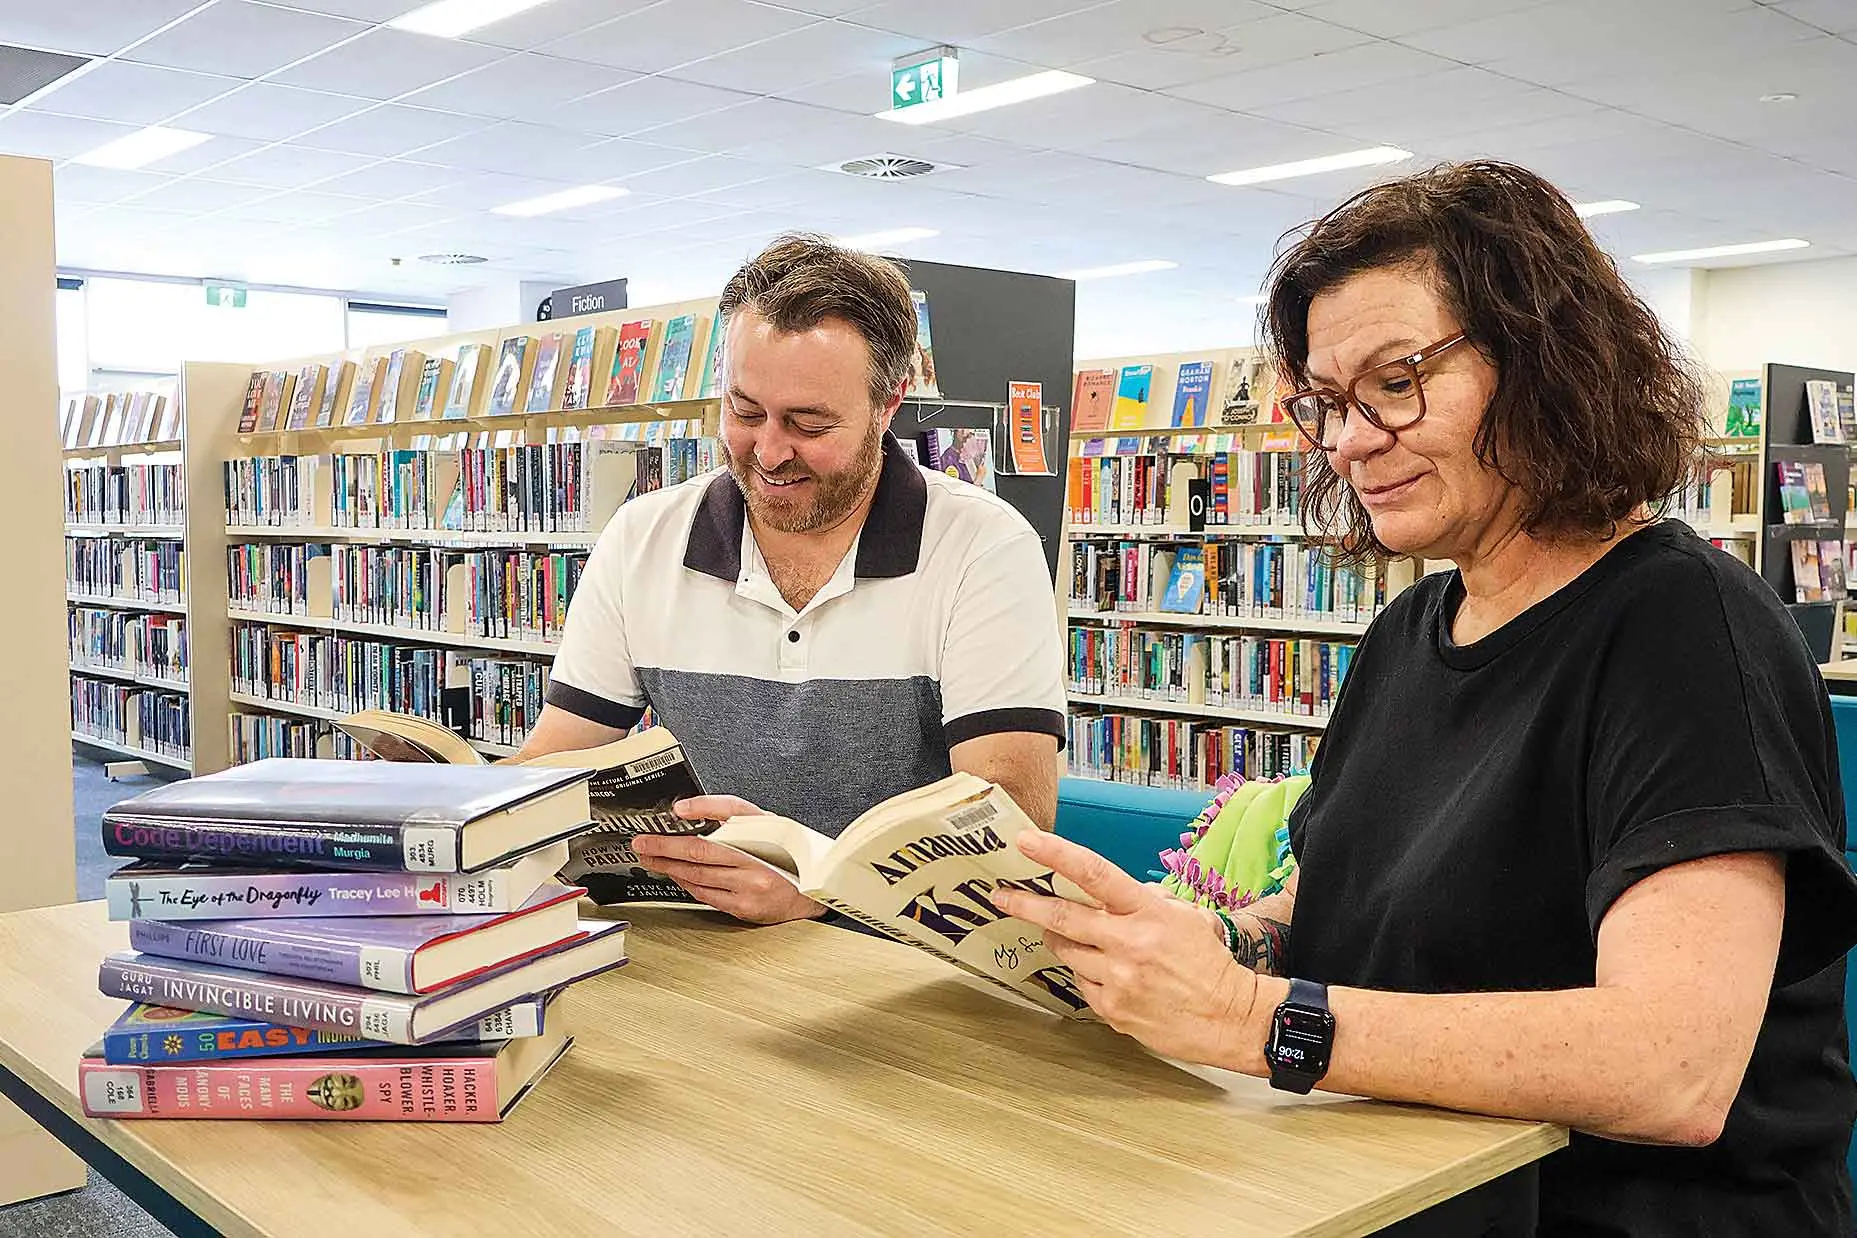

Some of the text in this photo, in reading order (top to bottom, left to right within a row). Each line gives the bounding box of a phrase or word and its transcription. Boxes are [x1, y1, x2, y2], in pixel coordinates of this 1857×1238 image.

[572, 294, 604, 313] Fiction
[1190, 495, 1203, 516] O
[475, 673, 484, 698] CULT
[448, 707, 462, 730] L
[602, 777, 624, 785] ACTUAL
[615, 779, 643, 789] ORIGINAL
[588, 790, 616, 798] ARCOS
[114, 822, 325, 856] Code Dependent
[333, 831, 393, 845] Madhumita
[333, 846, 371, 859] Murgia
[582, 846, 608, 857] HOW
[584, 851, 639, 868] PABLO
[159, 885, 323, 911] The Eye of the Dragonfly
[328, 886, 415, 901] Tracey Lee H
[458, 887, 466, 903] 070
[478, 880, 486, 906] HOLM
[186, 931, 226, 957] FIRST
[231, 939, 270, 964] LOVE
[121, 971, 152, 985] GURU
[119, 982, 154, 996] JAGAT
[163, 978, 354, 1027] INVINCIBLE LIVING
[200, 1032, 215, 1052] 50
[216, 1025, 313, 1051] EASY
[1279, 1046, 1304, 1060] 12:06
[106, 1080, 116, 1104] COLE
[217, 1086, 230, 1101] OF
[238, 1074, 253, 1110] FACES
[259, 1077, 273, 1108] MANY
[279, 1082, 294, 1103] THE
[378, 1082, 392, 1104] SPY
[400, 1067, 414, 1117] BLOWER.
[421, 1065, 436, 1117] WHISTLE-
[442, 1068, 457, 1116] HOAXER.
[464, 1068, 478, 1116] HACKER.
